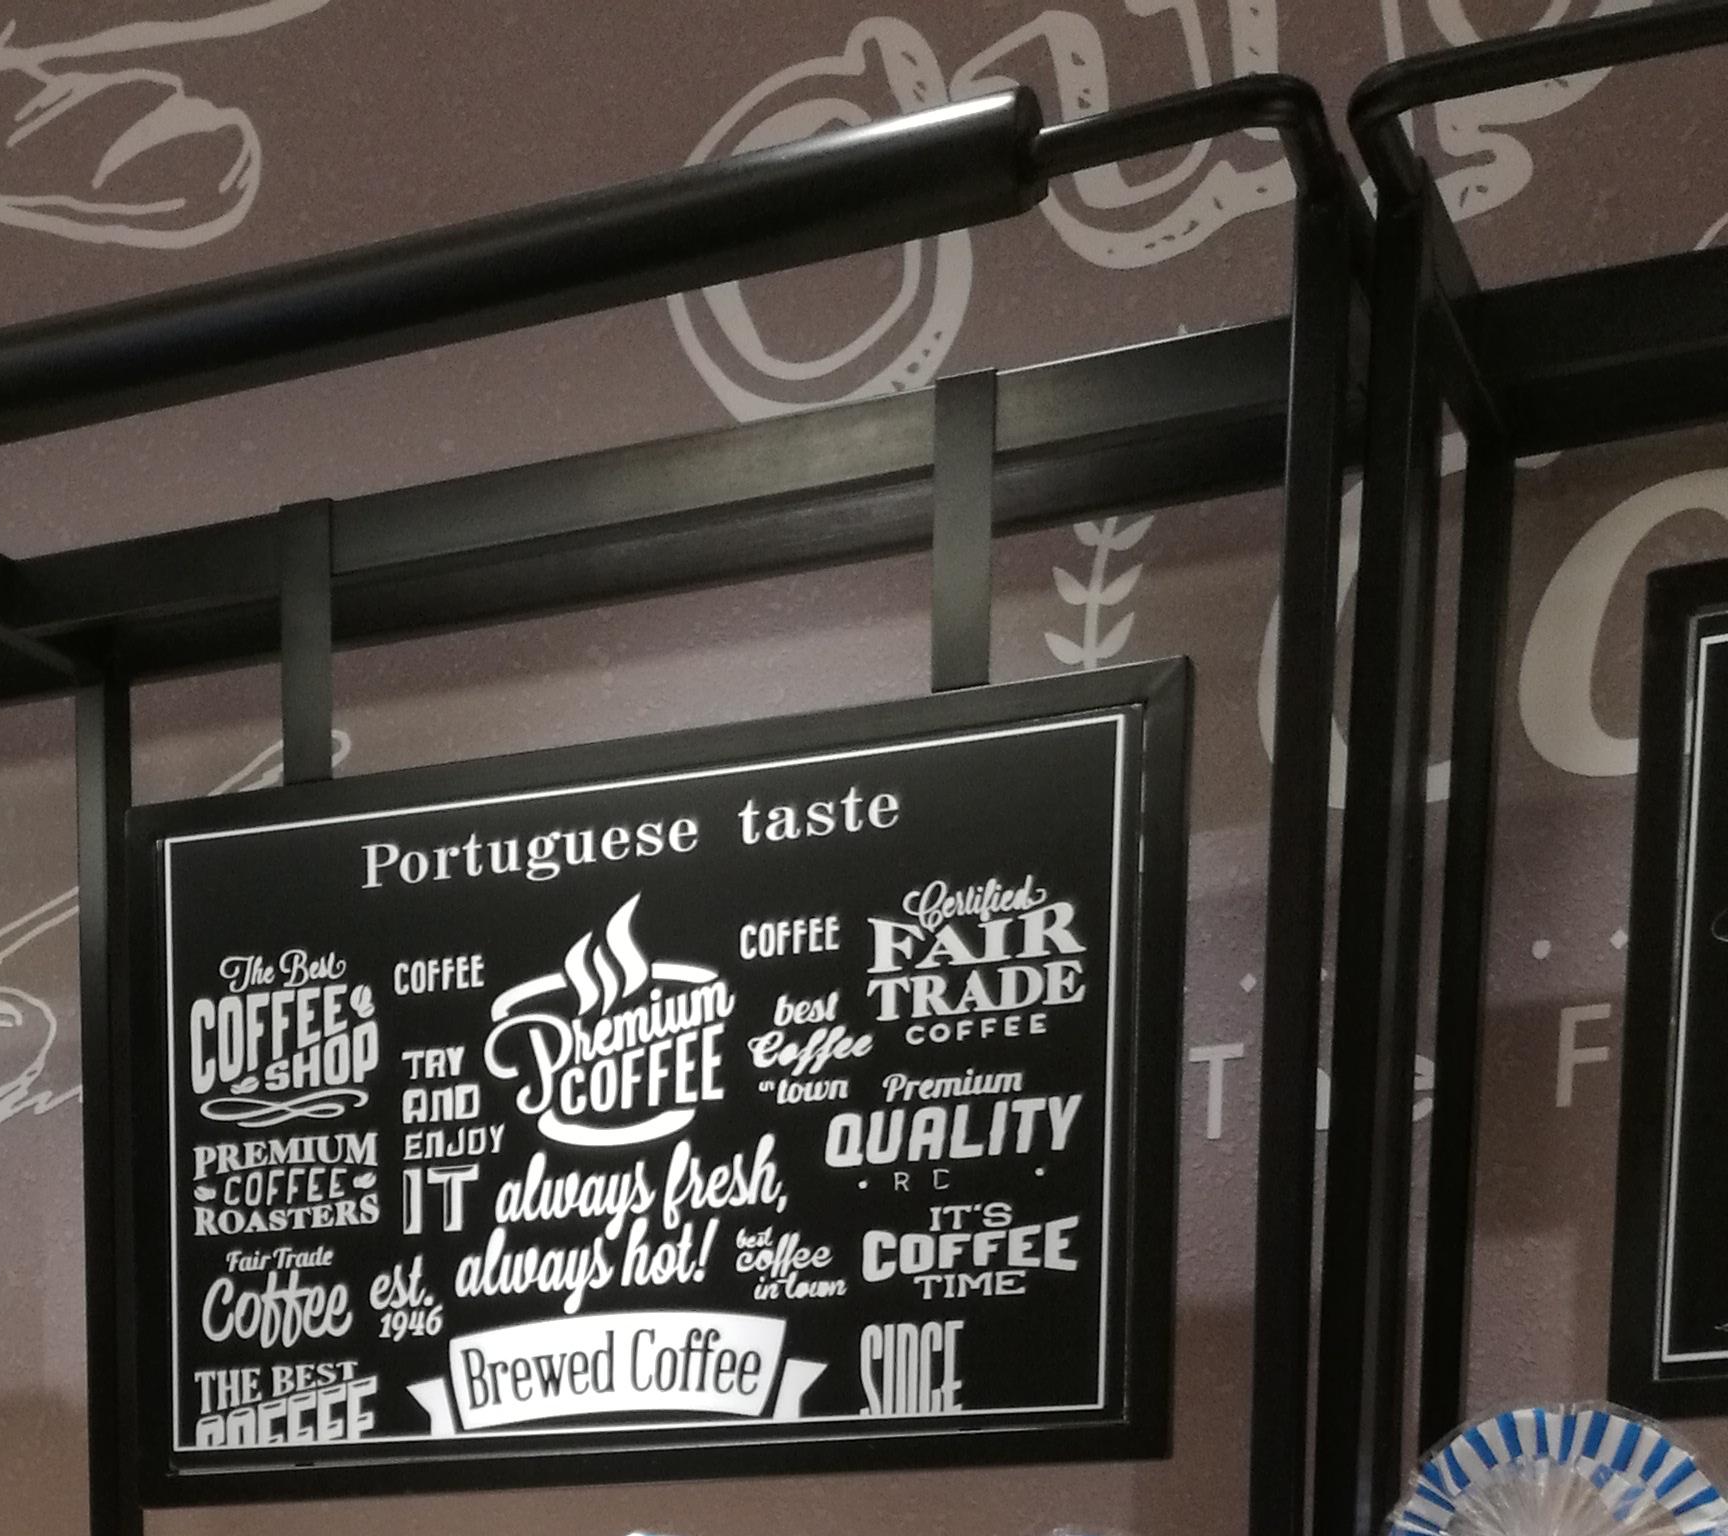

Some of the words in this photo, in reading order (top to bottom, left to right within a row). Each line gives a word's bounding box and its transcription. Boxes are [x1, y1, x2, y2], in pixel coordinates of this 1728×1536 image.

[361, 816, 699, 889] Portuguese
[738, 785, 900, 846] taste
[902, 874, 1047, 933] Certified
[739, 916, 840, 960] COFFEE
[867, 901, 1087, 974] FAIR
[220, 955, 275, 993] The
[279, 949, 346, 988] Best
[393, 954, 485, 996] COFFEE
[867, 960, 1087, 1022] TRADE
[773, 991, 839, 1026] best
[905, 1013, 1048, 1045] COFFEE
[190, 984, 348, 1094] COFFEE
[265, 1020, 379, 1092] SHOP
[401, 1046, 465, 1080] TRY
[484, 981, 735, 1115] Premium
[747, 1025, 873, 1077] Coffee
[560, 1023, 724, 1115] COFFEE
[777, 1078, 849, 1105] town
[882, 1068, 1023, 1102] Premium
[402, 1084, 480, 1124] AND
[403, 1123, 505, 1160] ENJOY
[825, 1094, 1083, 1168] QUALITY
[193, 1132, 378, 1181] PREMIUM
[224, 1167, 347, 1207] COFFEE
[403, 1163, 479, 1235] IT
[495, 1152, 656, 1240] always
[663, 1133, 788, 1230] fresh,
[194, 1193, 381, 1236] ROASTERS
[736, 1227, 772, 1249] best
[929, 1202, 1013, 1232] IT'S
[226, 1250, 271, 1272] Fair
[273, 1246, 334, 1269] Trade
[455, 1226, 614, 1314] always
[621, 1217, 720, 1287] hot!
[736, 1232, 833, 1279] coffee
[862, 1215, 1080, 1283] COFFEE
[369, 1254, 434, 1310] est.
[753, 1276, 779, 1300] in
[781, 1272, 847, 1299] town
[913, 1270, 1026, 1300] TIME
[202, 1269, 353, 1348] Coffee
[379, 1304, 444, 1342] 1946
[194, 1368, 262, 1415] THE
[272, 1361, 359, 1398] BEST
[461, 1330, 615, 1410] Brewed
[630, 1328, 761, 1396] Coffee
